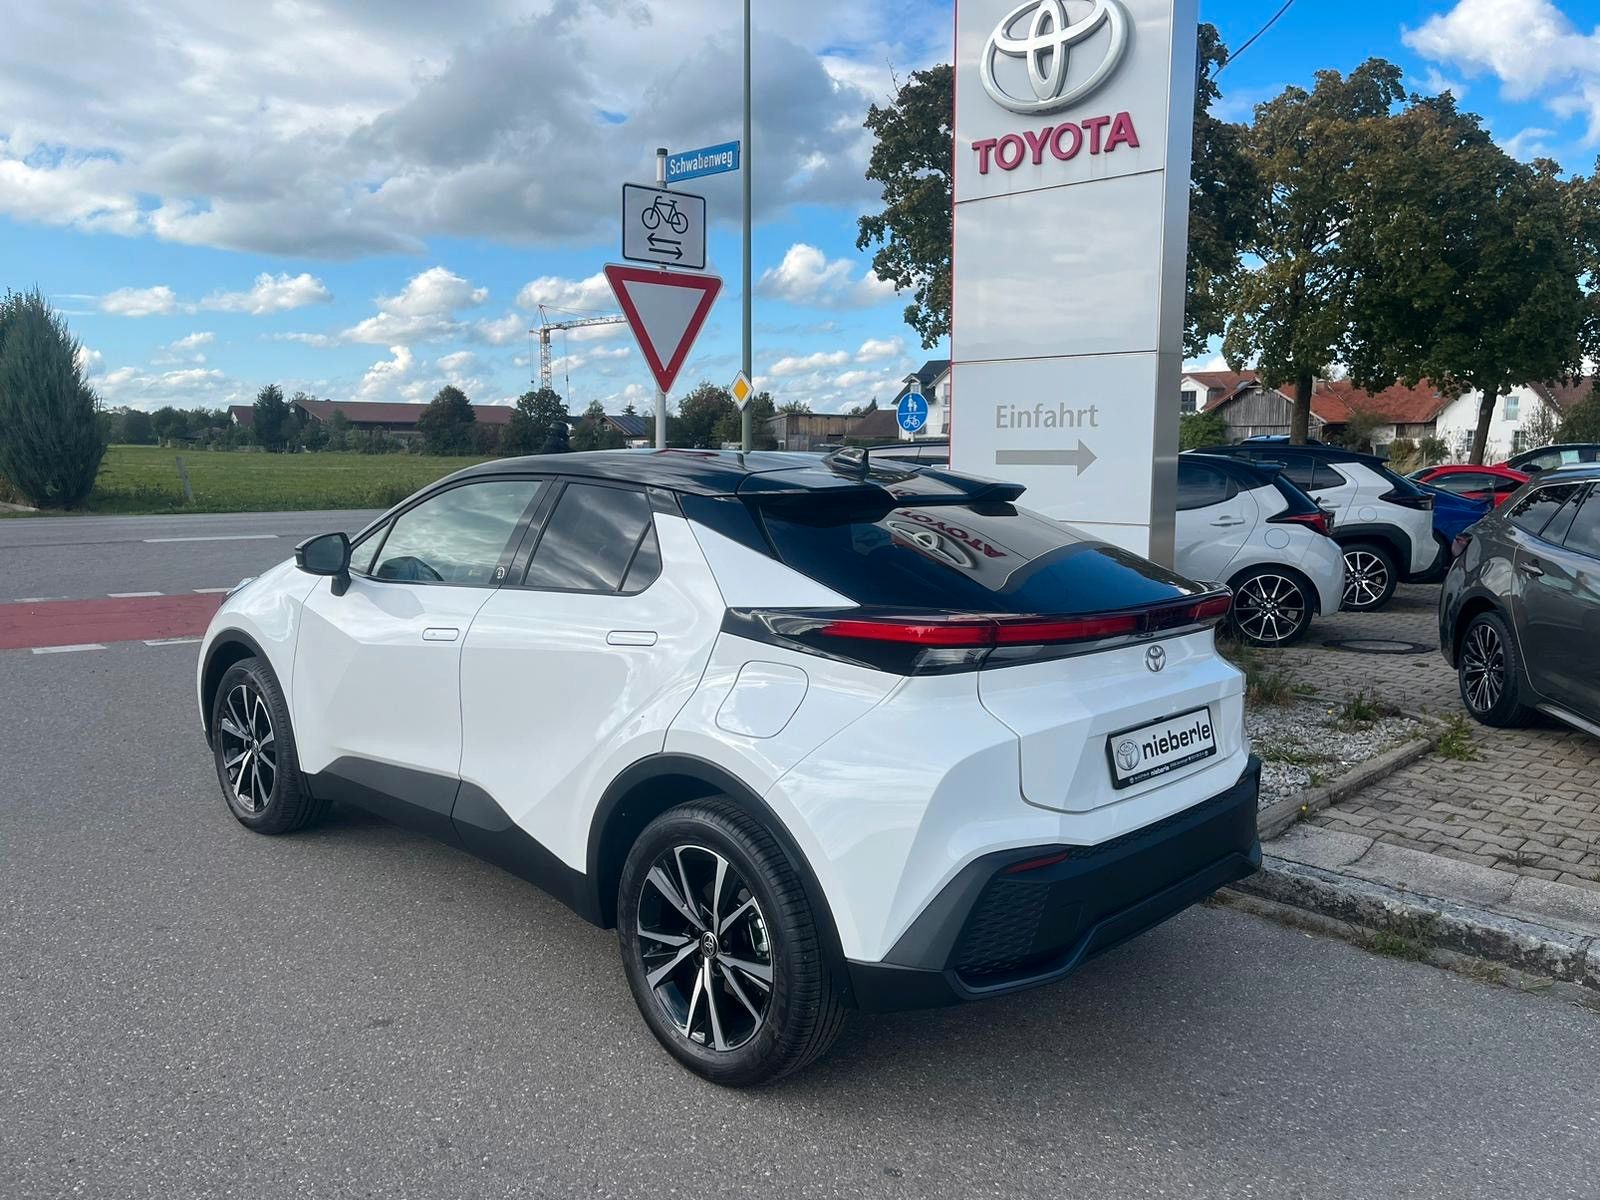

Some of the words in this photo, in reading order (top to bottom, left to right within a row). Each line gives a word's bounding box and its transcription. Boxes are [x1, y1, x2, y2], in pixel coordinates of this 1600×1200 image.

[972, 111, 1140, 175] TOYOTA
[670, 150, 733, 175] Schwabenweg
[996, 402, 1099, 428] Einfahrt
[1142, 721, 1211, 760] nieberle
